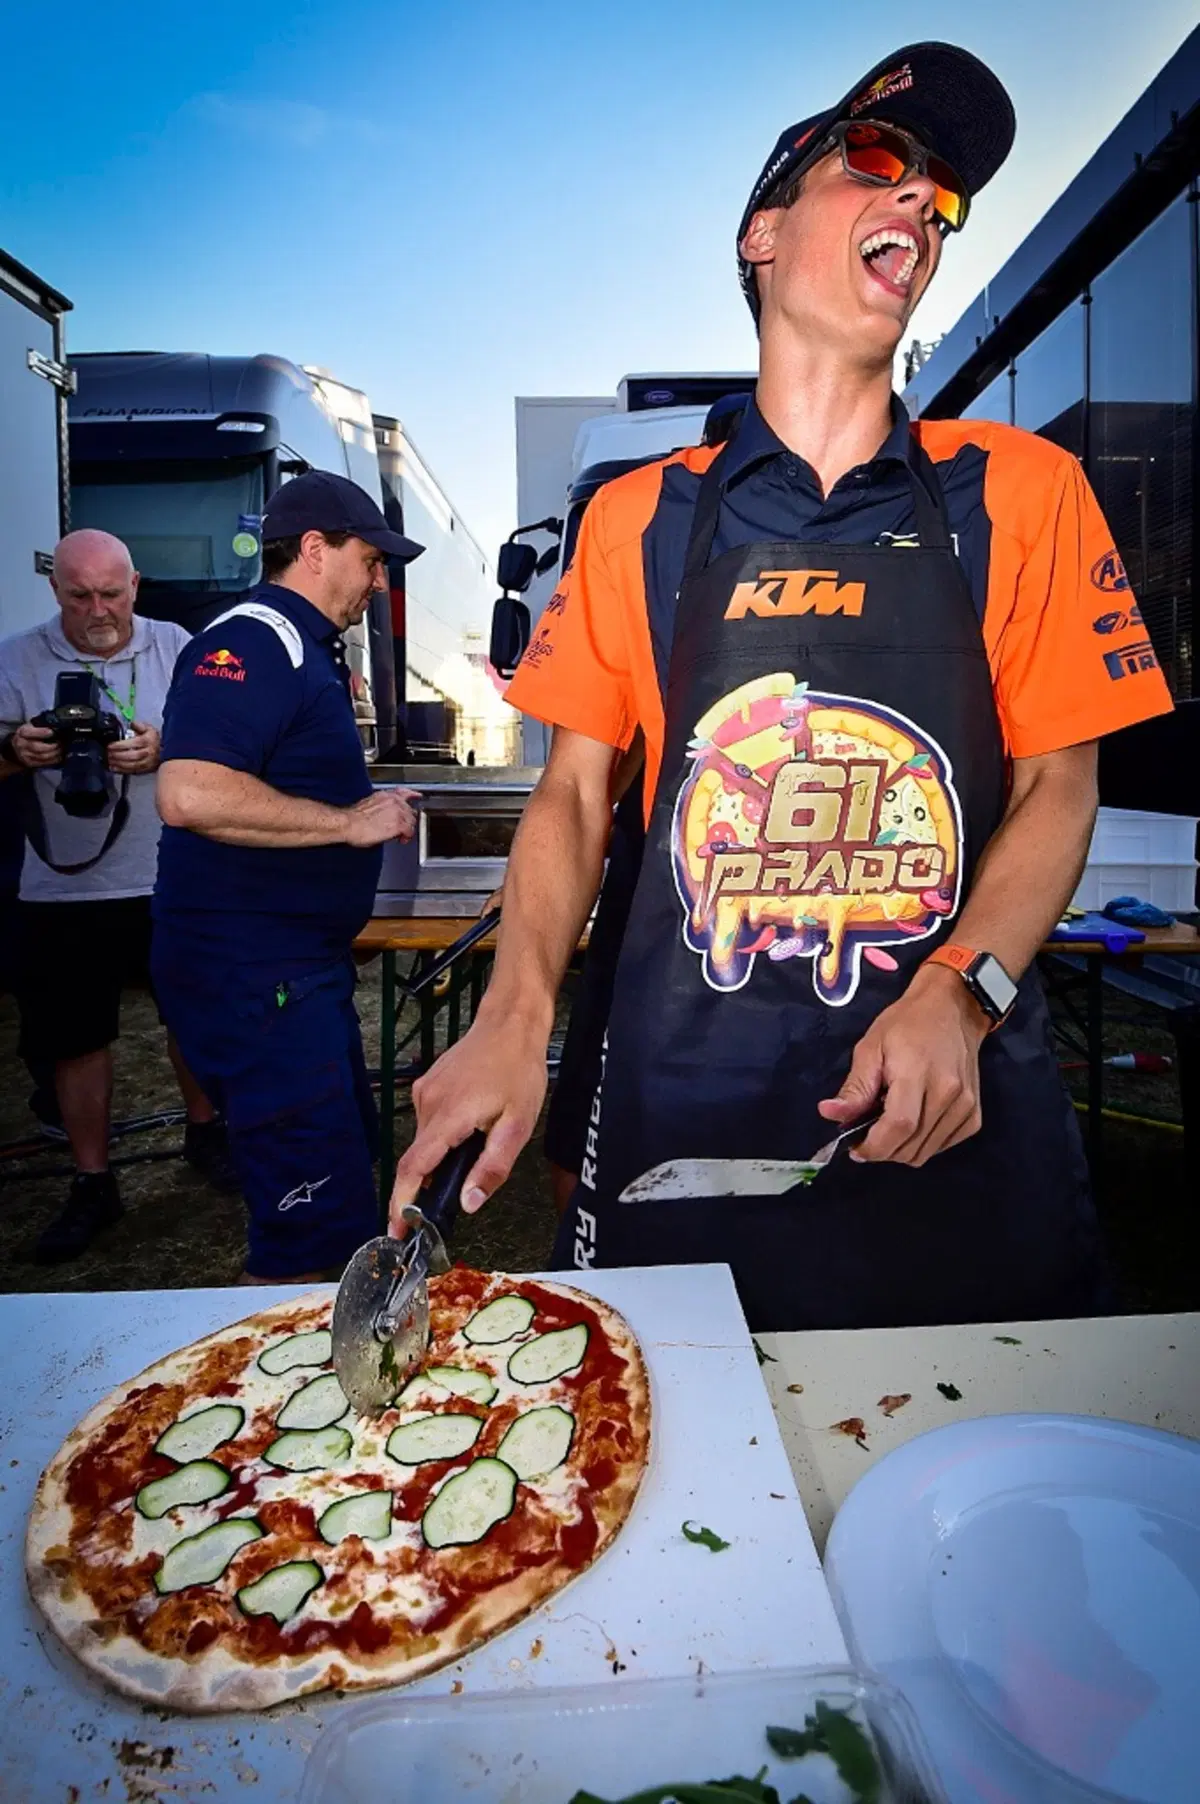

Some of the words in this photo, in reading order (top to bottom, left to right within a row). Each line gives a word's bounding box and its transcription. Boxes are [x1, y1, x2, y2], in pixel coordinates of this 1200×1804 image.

[723, 569, 867, 620] KTM
[194, 665, 219, 676] Red
[219, 667, 246, 682] Bull
[763, 760, 885, 845] 61
[706, 847, 945, 908] PRADO
